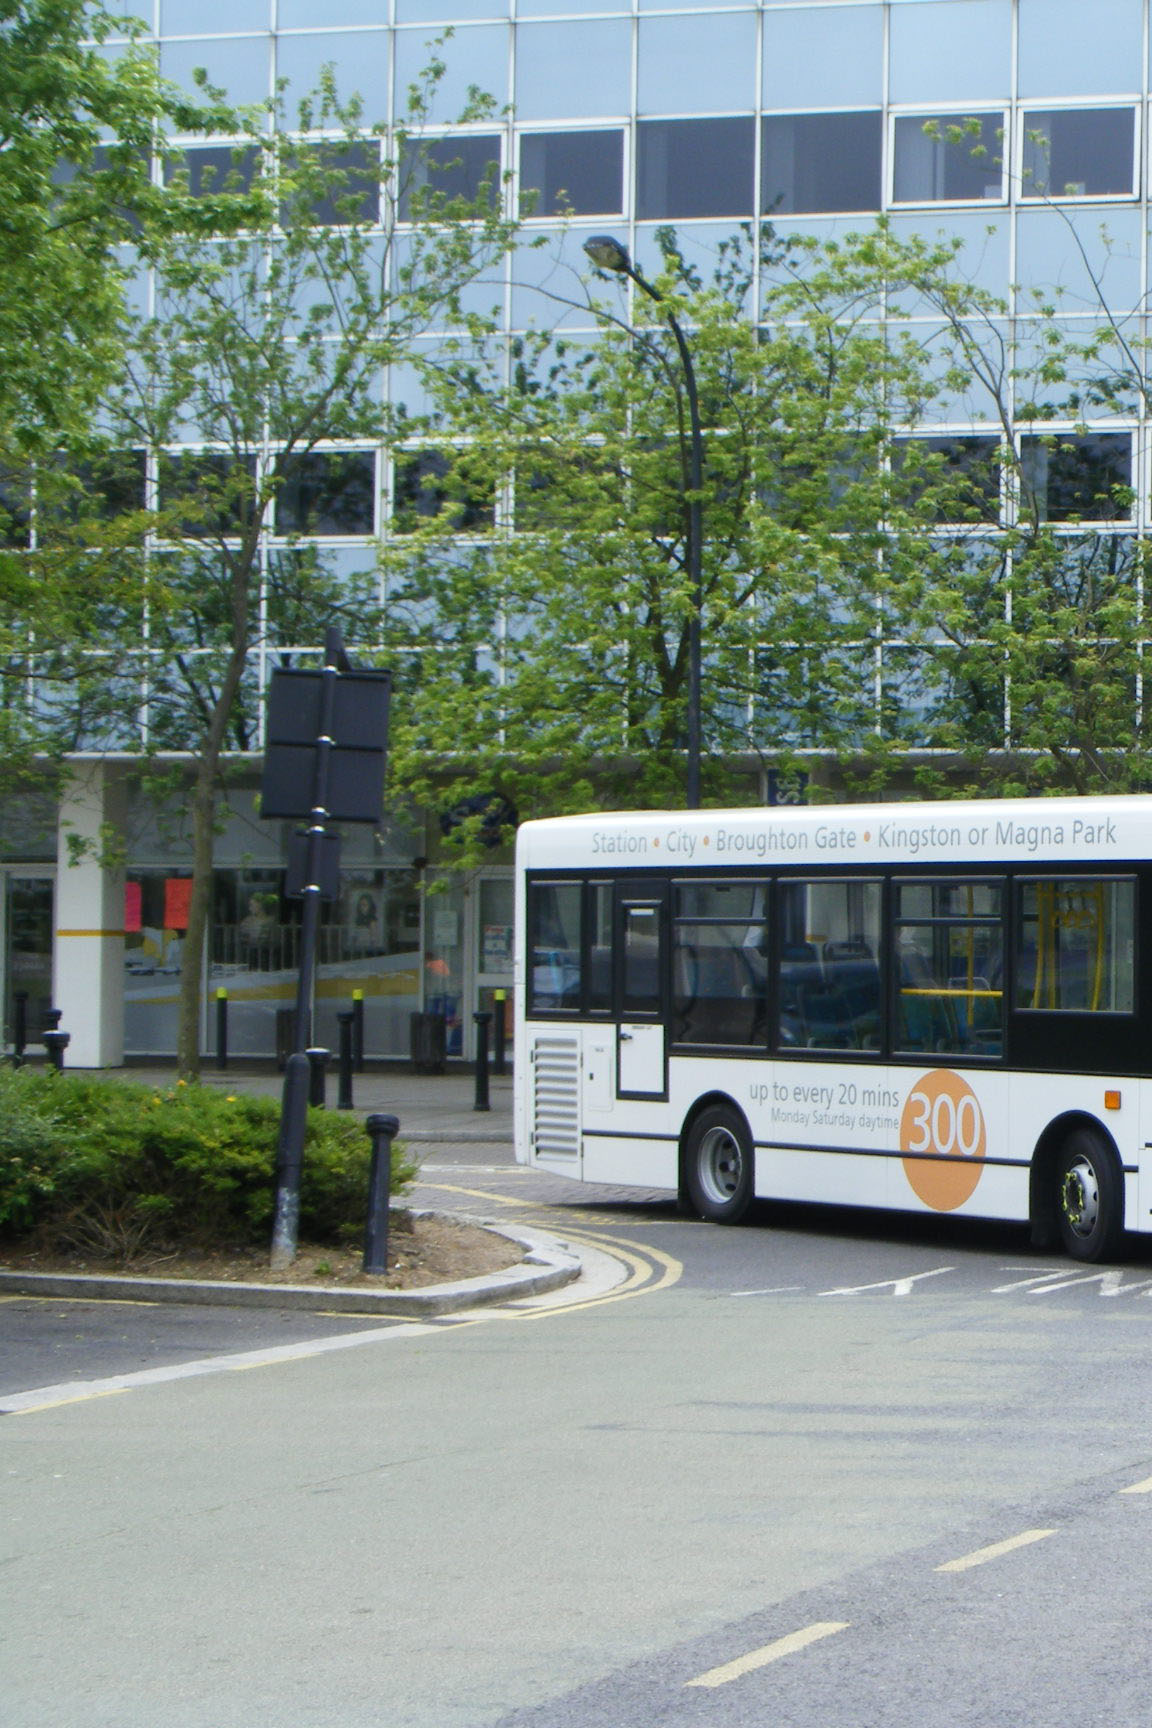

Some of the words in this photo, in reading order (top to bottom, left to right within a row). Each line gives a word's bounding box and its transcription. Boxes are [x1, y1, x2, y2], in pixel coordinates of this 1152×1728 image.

[591, 829, 648, 853] Station
[666, 828, 697, 858] City
[716, 825, 808, 856] Broughton
[815, 826, 857, 849] Gate
[878, 822, 962, 854] Kingston
[969, 825, 989, 845] or
[995, 820, 1065, 852] Magna
[1072, 817, 1117, 845] Park
[750, 1083, 768, 1105] up
[773, 1081, 788, 1101] to
[793, 1087, 834, 1110] every
[838, 1083, 858, 1105] 20
[862, 1084, 899, 1108] mins
[770, 1107, 809, 1128] Monday
[812, 1109, 857, 1130] Saturday
[858, 1112, 899, 1132] daytime
[908, 1091, 981, 1156] 300
